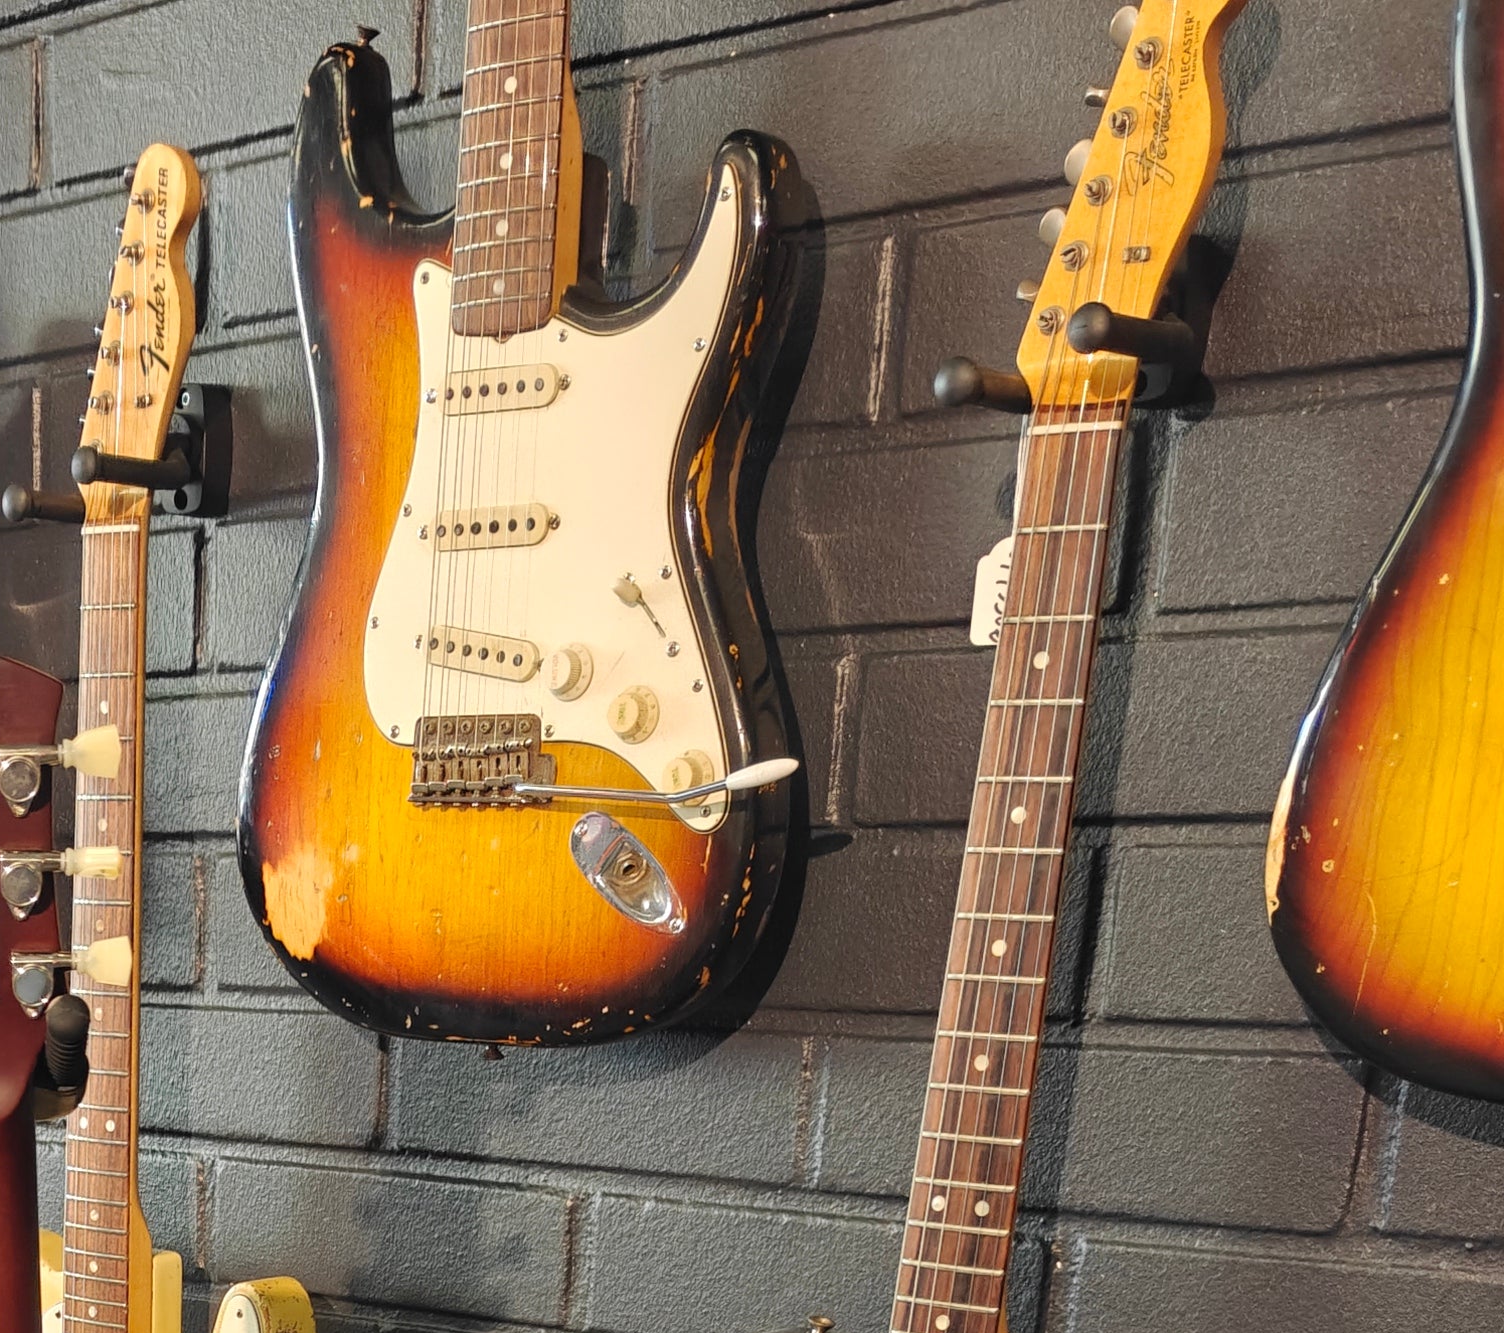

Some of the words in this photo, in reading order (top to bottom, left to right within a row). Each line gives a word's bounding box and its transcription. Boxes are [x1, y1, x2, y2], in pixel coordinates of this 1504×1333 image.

[1123, 57, 1175, 197] Fender
[139, 278, 170, 376] Fender
[155, 167, 169, 269] TELECASTER
